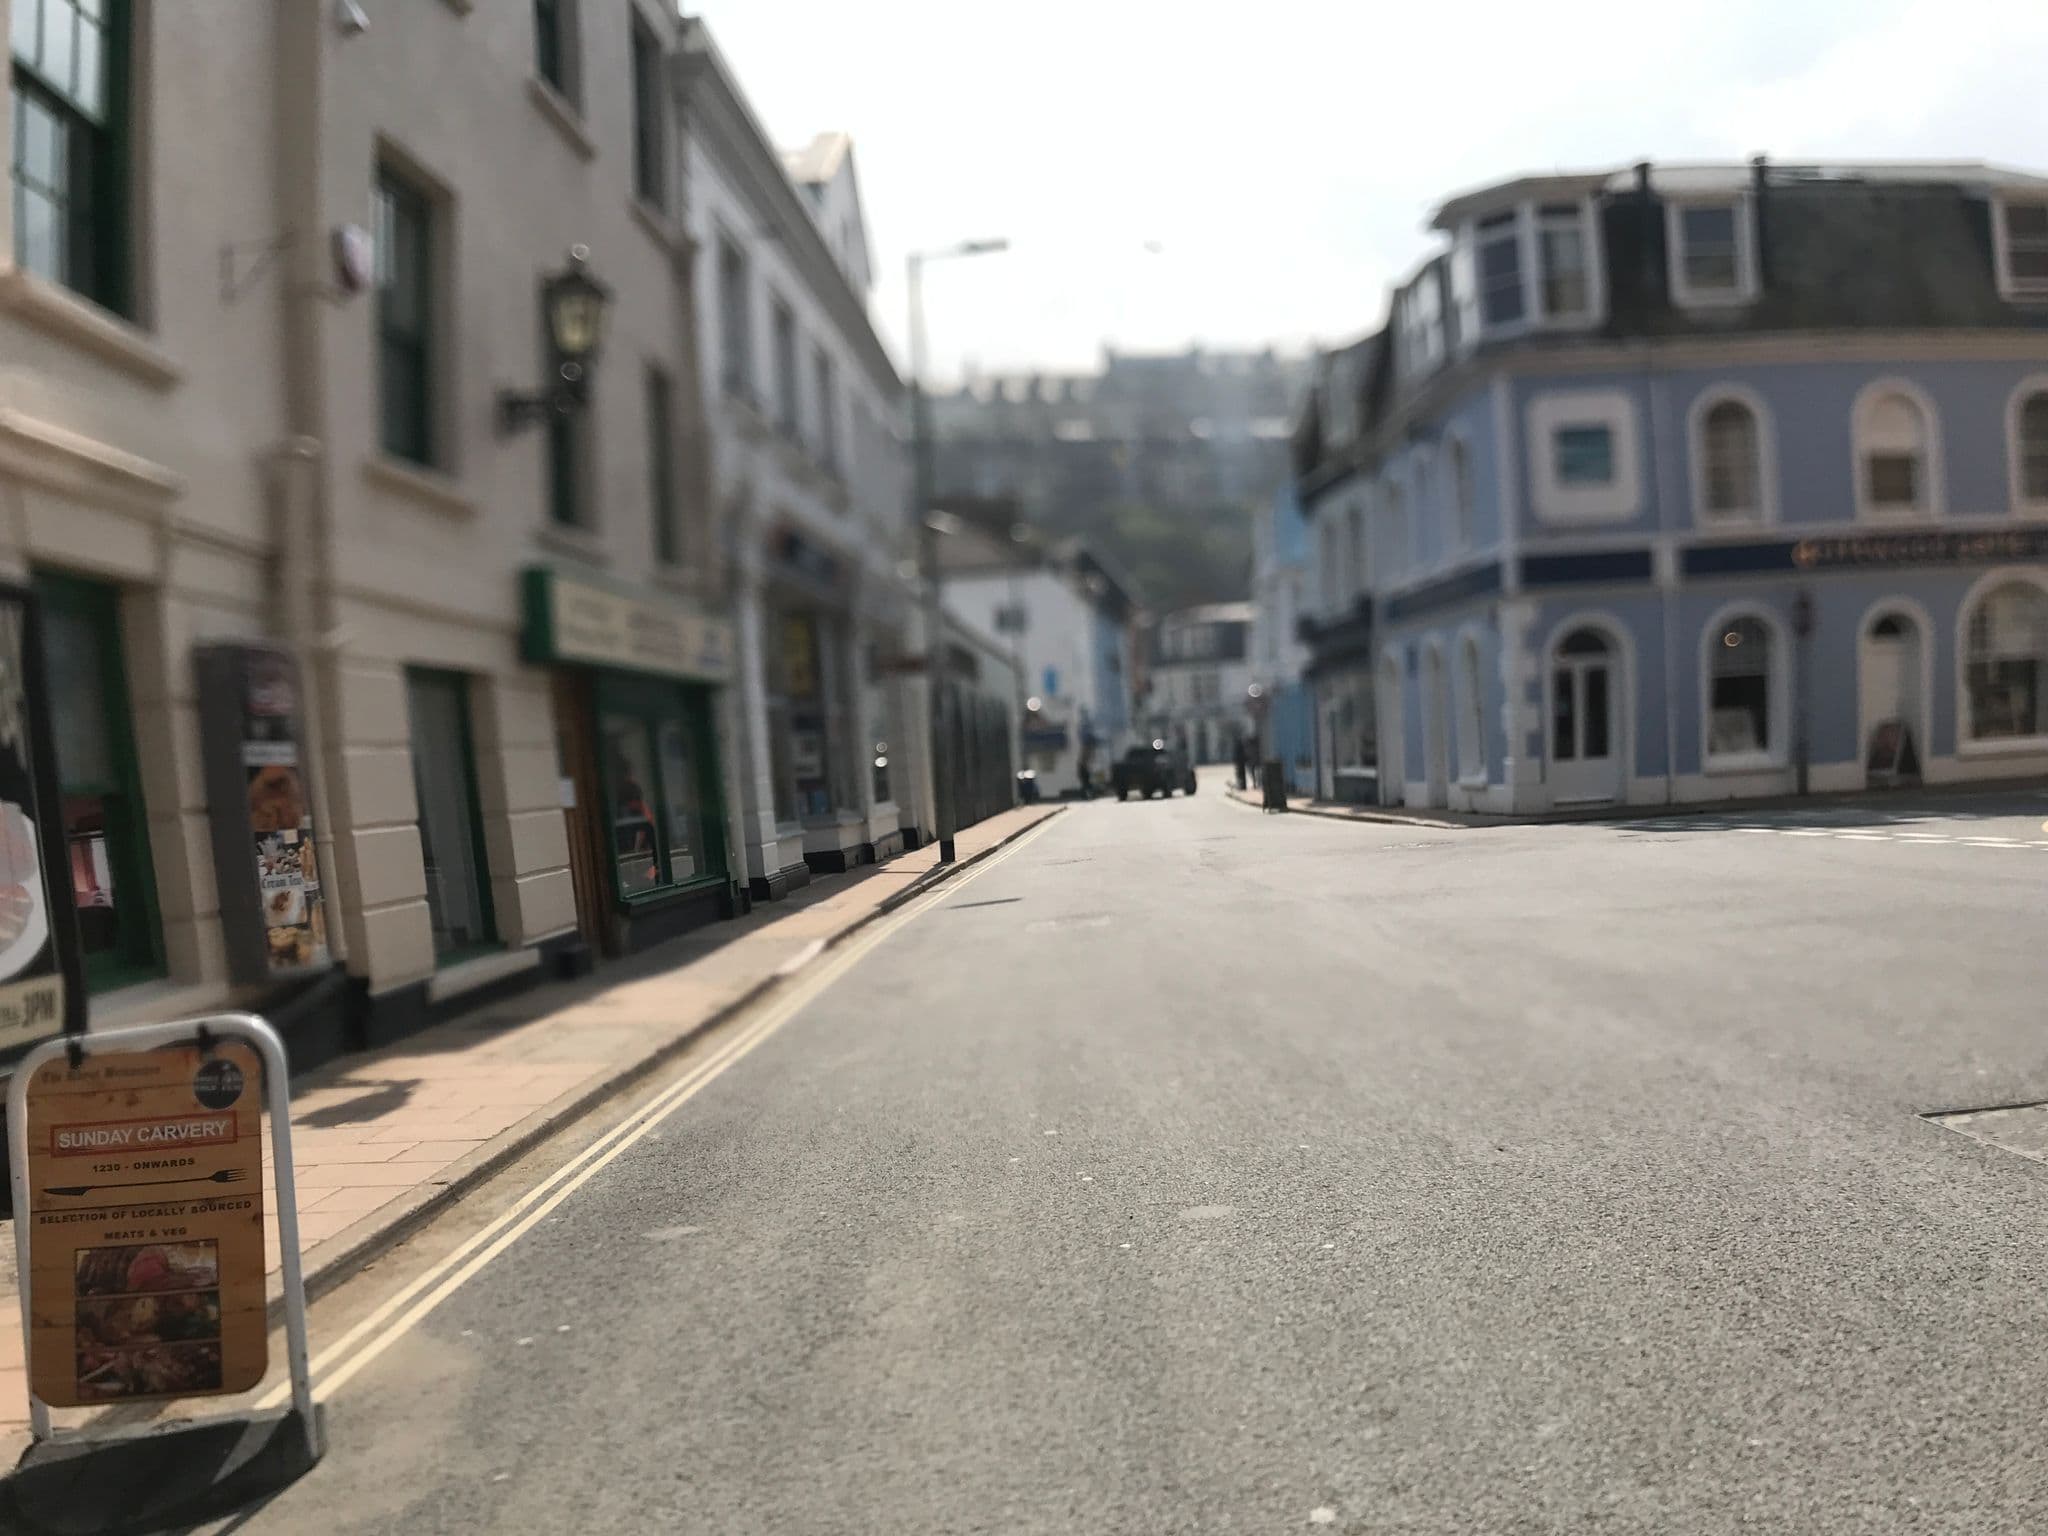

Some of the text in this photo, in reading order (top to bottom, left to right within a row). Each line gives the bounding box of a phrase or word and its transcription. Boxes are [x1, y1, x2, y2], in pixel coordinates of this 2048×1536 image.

[58, 1119, 228, 1148] SUNDAY CARVERY
[92, 1163, 121, 1173] 1230
[133, 1157, 196, 1171] ONWARDS
[39, 1201, 252, 1225] SELECTION OF LOCALLY SOURCED
[104, 1227, 188, 1240] MEATS & VEG
